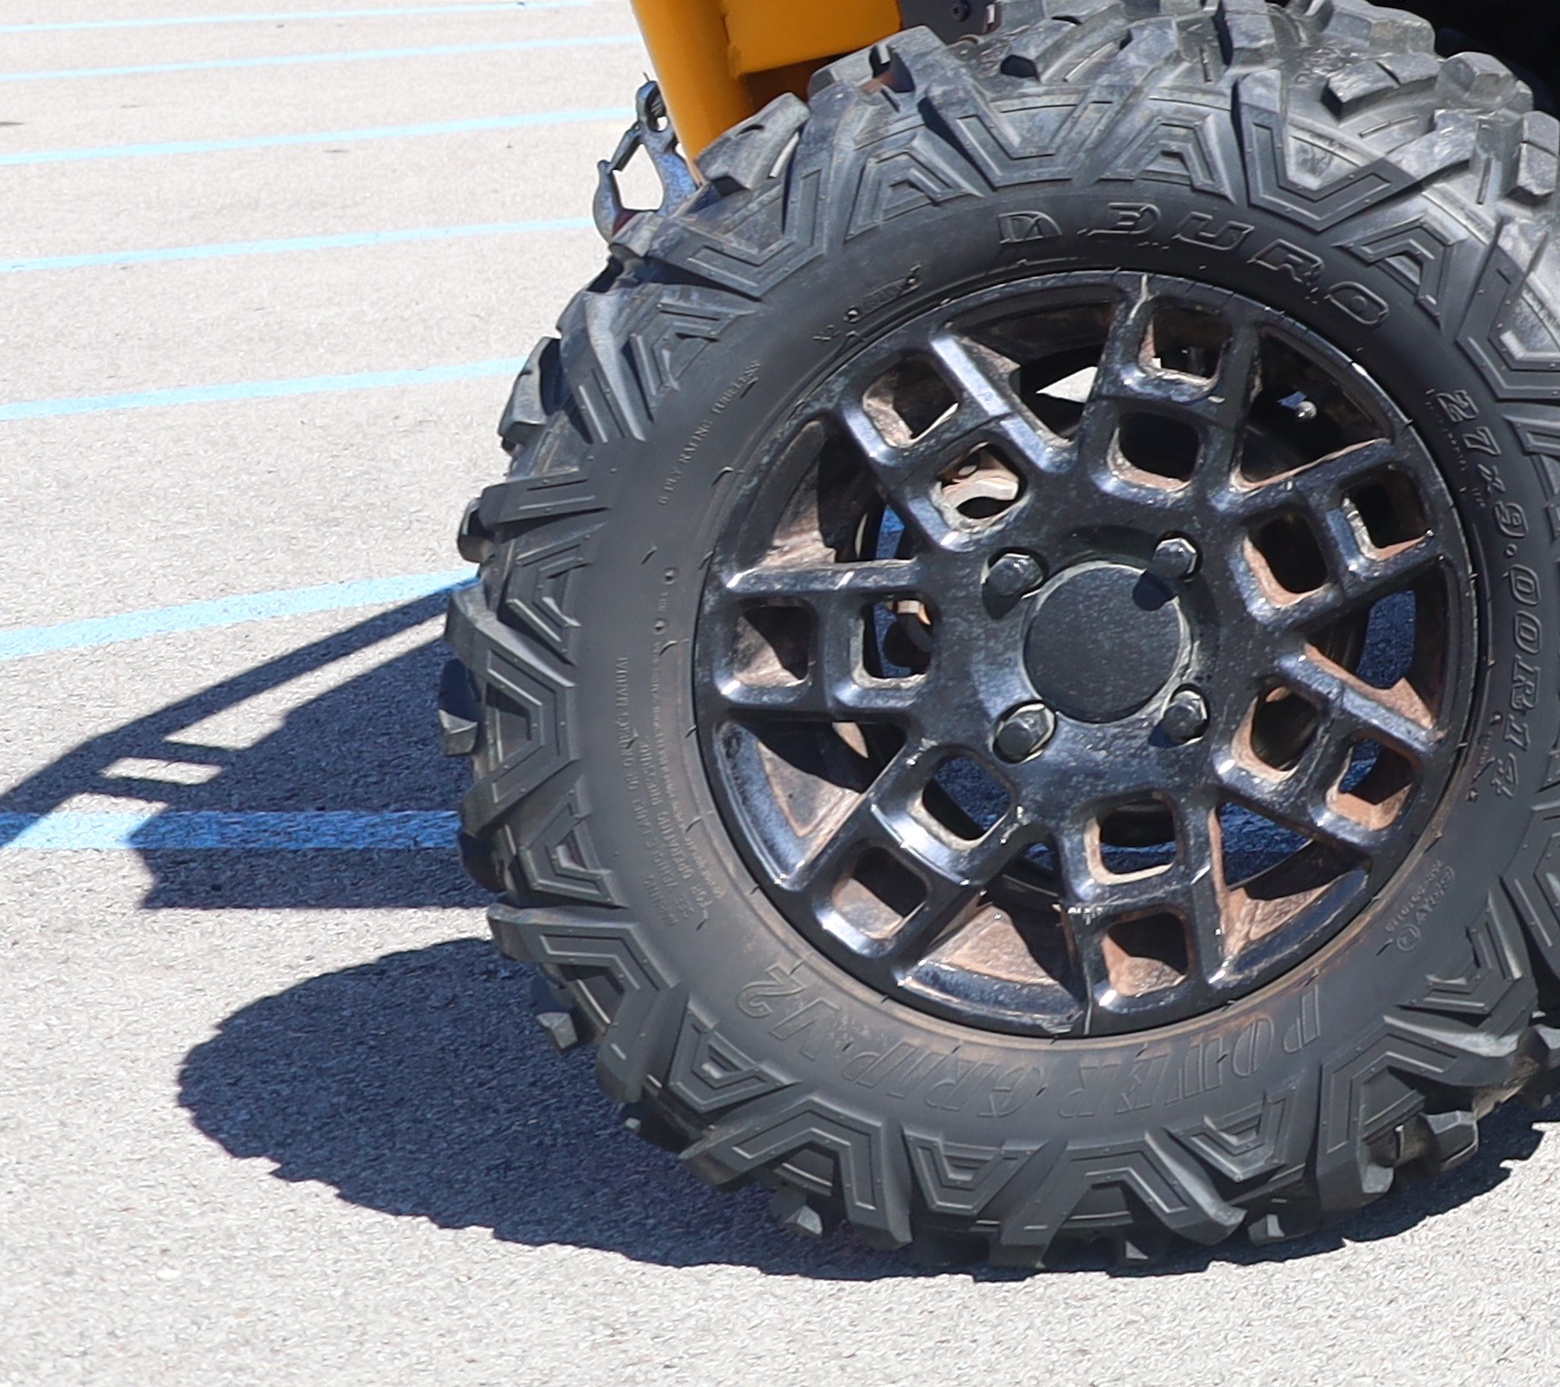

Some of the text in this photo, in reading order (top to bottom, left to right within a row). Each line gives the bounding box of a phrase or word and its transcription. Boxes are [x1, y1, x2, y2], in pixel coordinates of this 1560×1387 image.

[1078, 201, 1390, 330] DURO
[1437, 387, 1543, 797] 27x9.00R14
[734, 960, 1322, 1119] POWER GRIP V2
